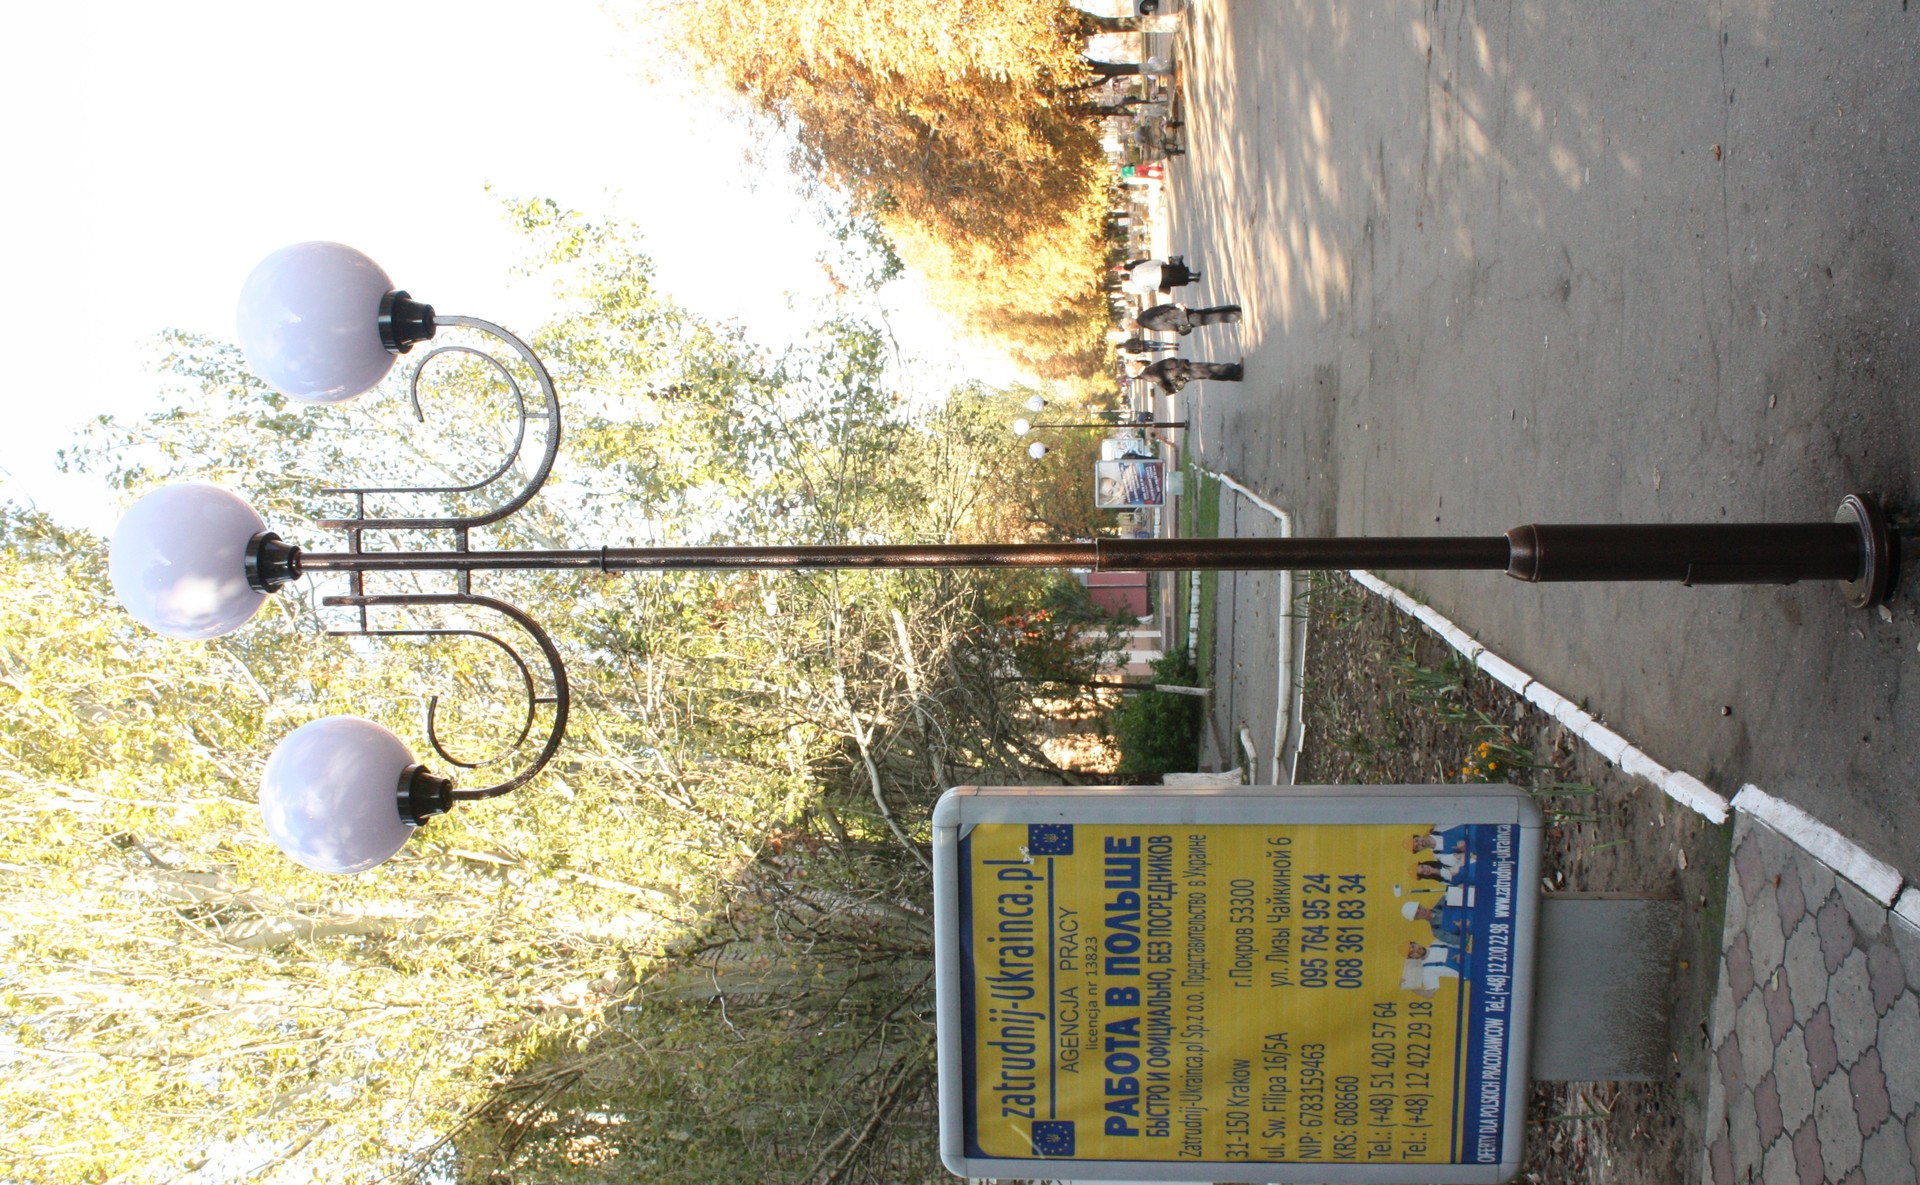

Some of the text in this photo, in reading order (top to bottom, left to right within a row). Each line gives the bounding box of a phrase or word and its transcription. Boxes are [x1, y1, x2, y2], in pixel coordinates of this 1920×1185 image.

[1182, 835, 1212, 878] Украине
[1229, 879, 1254, 923] 53300
[1265, 837, 1295, 987] ул. Лизы Чайкиной 6
[1104, 836, 1141, 1137] РАБОТА В ПОЛЬШЕ
[1146, 835, 1178, 1138] БЫСТРО И ОФИЦИАЛЬНО, БЕЗ ПОСРЕДНИКОВ
[1181, 892, 1211, 987] Представительство
[1299, 873, 1331, 989] 095 764 95 24
[1334, 874, 1367, 989] 068 361 83 34
[1485, 923, 1510, 1012] Tel.: (+48) 12 200 22 98
[982, 859, 1045, 1119] zatrudnij-Ukrainca.pl
[1059, 906, 1079, 1073] AGENCJA PRACY
[1085, 936, 1100, 1050] licencja nr 13823
[1177, 1041, 1210, 1158] Zatrudnij-Ukrainca.pl
[1225, 1058, 1250, 1158] 31-150 Krakow
[1261, 1032, 1292, 1072] 16/5A
[1261, 1076, 1292, 1112] Filipa
[1299, 1043, 1325, 1159] NIP: 6783159463
[1367, 1002, 1399, 1159] Tel.: (+48) 51 420 57 64
[1401, 1001, 1434, 1159] Tel.: (+48) 12 422 29 18
[1477, 1017, 1504, 1163] OFERTY DLA POLSKICH PRACODAWCOW
[1260, 1143, 1285, 1159] ul.
[1333, 1076, 1359, 1159] KRS: 608660
